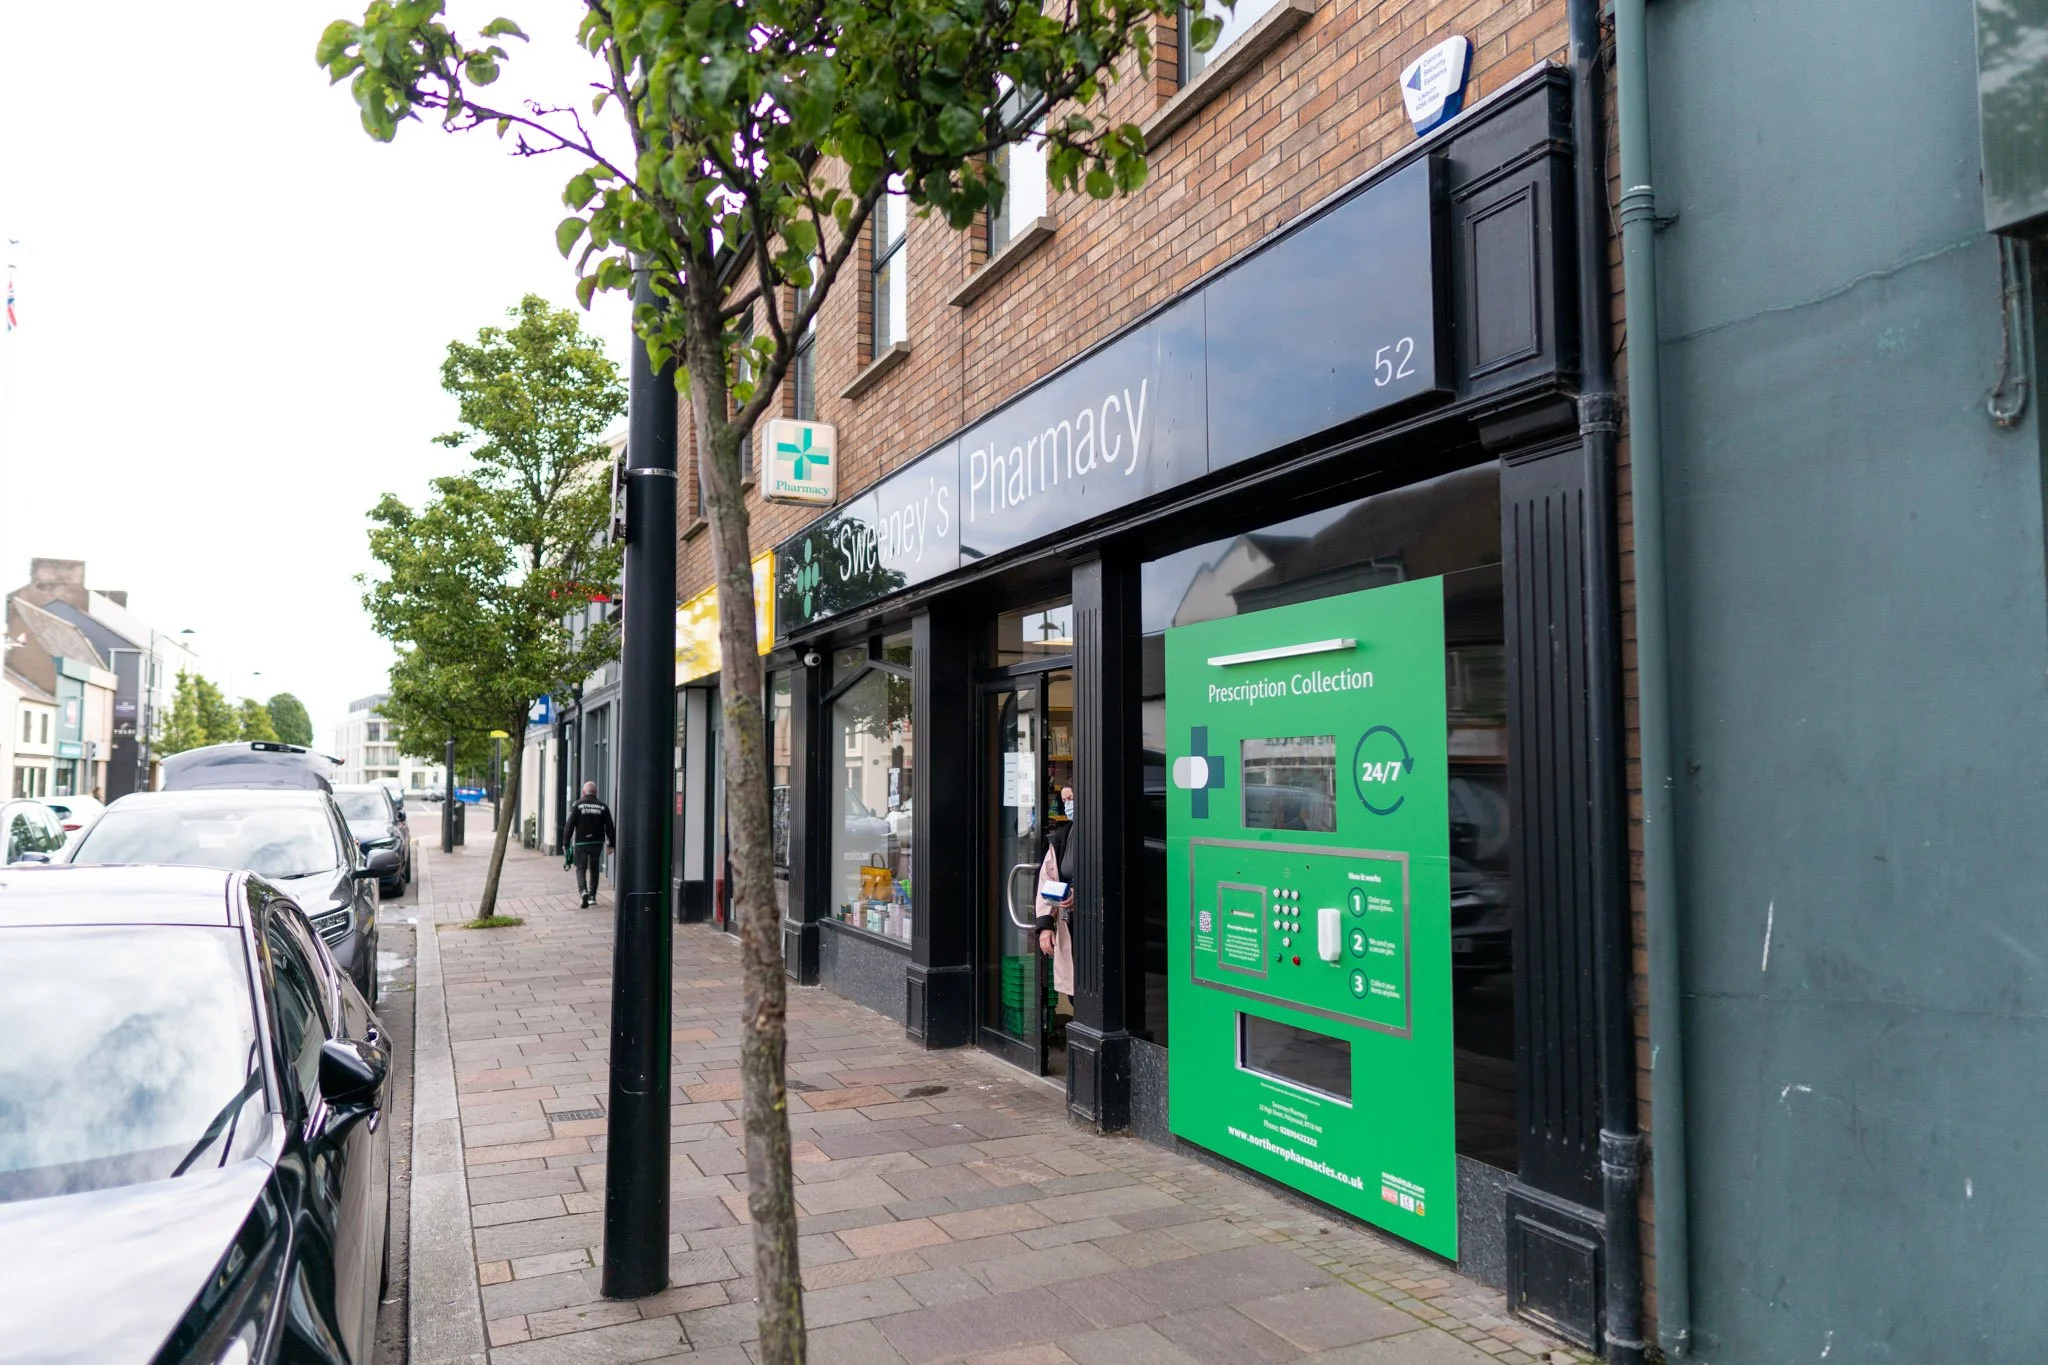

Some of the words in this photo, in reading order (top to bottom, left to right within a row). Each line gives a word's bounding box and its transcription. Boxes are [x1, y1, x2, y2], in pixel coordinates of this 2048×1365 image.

[1423, 49, 1443, 67] Central
[1423, 59, 1446, 77] Security
[1423, 67, 1447, 86] Systems
[1374, 336, 1415, 387] 52
[969, 378, 1148, 523] Pharmacy
[776, 480, 829, 496] Pharmacy
[1208, 678, 1286, 706] Prescription
[1290, 668, 1373, 695] Collection
[1362, 762, 1401, 785] 24/7
[1353, 895, 1360, 911] 1
[1353, 934, 1363, 951] 2
[1353, 975, 1363, 992] 3
[1370, 979, 1385, 988] Collect
[1263, 1119, 1279, 1132] Phone:
[1228, 1125, 1363, 1190] www.northernpharmacies.co.uk
